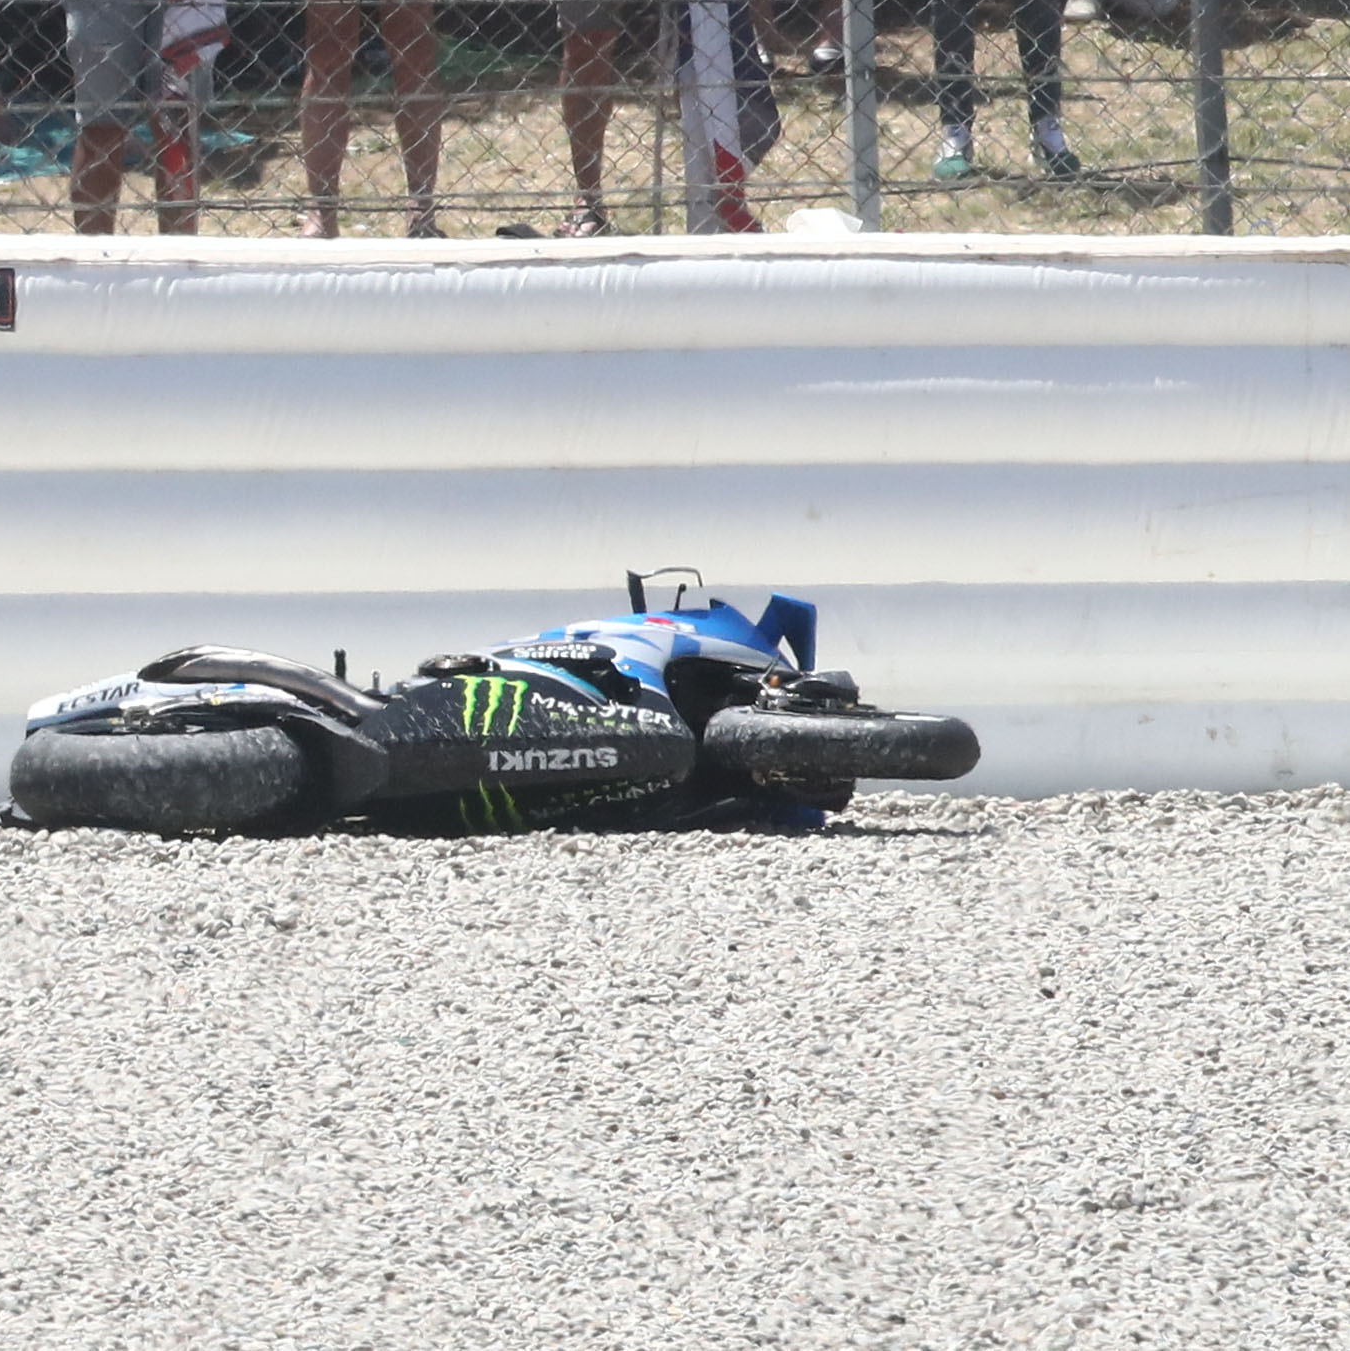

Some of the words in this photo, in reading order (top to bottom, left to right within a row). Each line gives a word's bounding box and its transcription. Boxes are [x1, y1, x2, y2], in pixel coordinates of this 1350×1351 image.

[56, 681, 140, 715] ECSTAR
[531, 692, 673, 729] MSTER
[489, 747, 618, 771] SUZUKI
